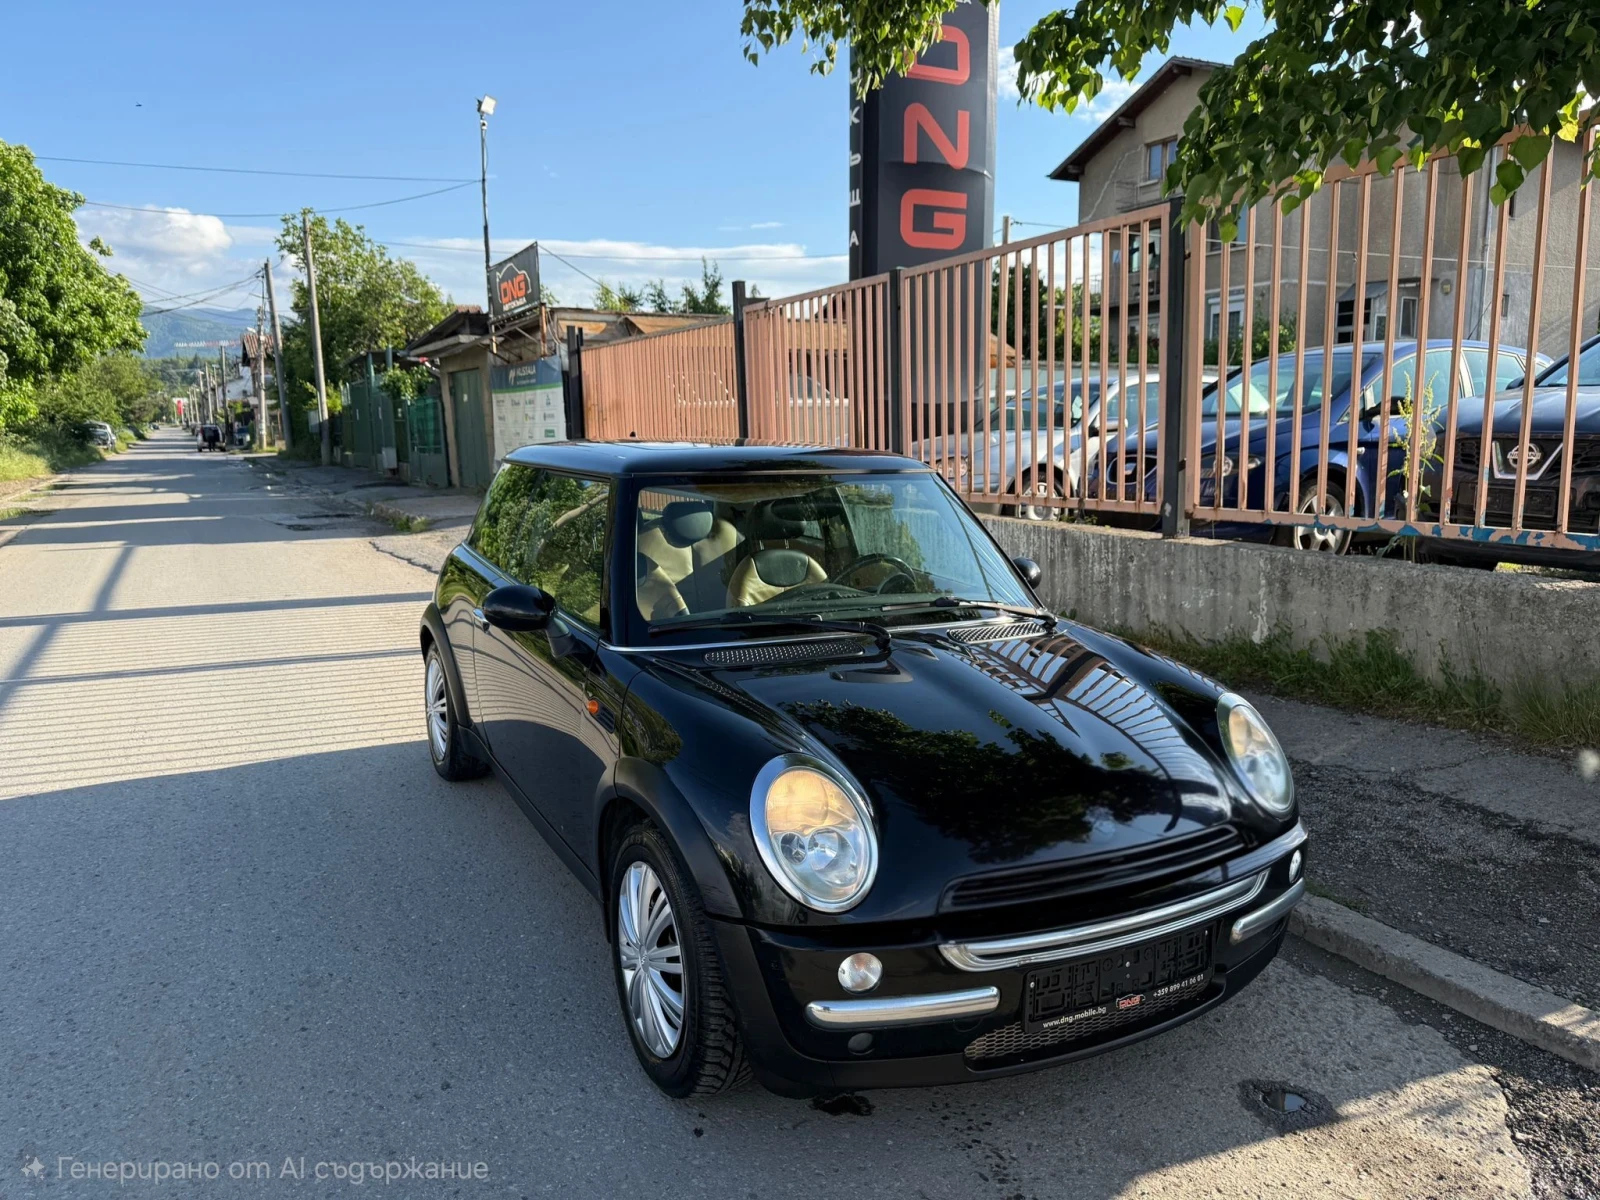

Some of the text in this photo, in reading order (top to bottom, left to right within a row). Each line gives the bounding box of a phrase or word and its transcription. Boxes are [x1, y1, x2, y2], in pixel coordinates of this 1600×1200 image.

[900, 24, 970, 250] DNG
[500, 274, 526, 304] DNG
[1153, 987, 1168, 997] +359
[1042, 1006, 1107, 1028] www.dng.mobile.bg
